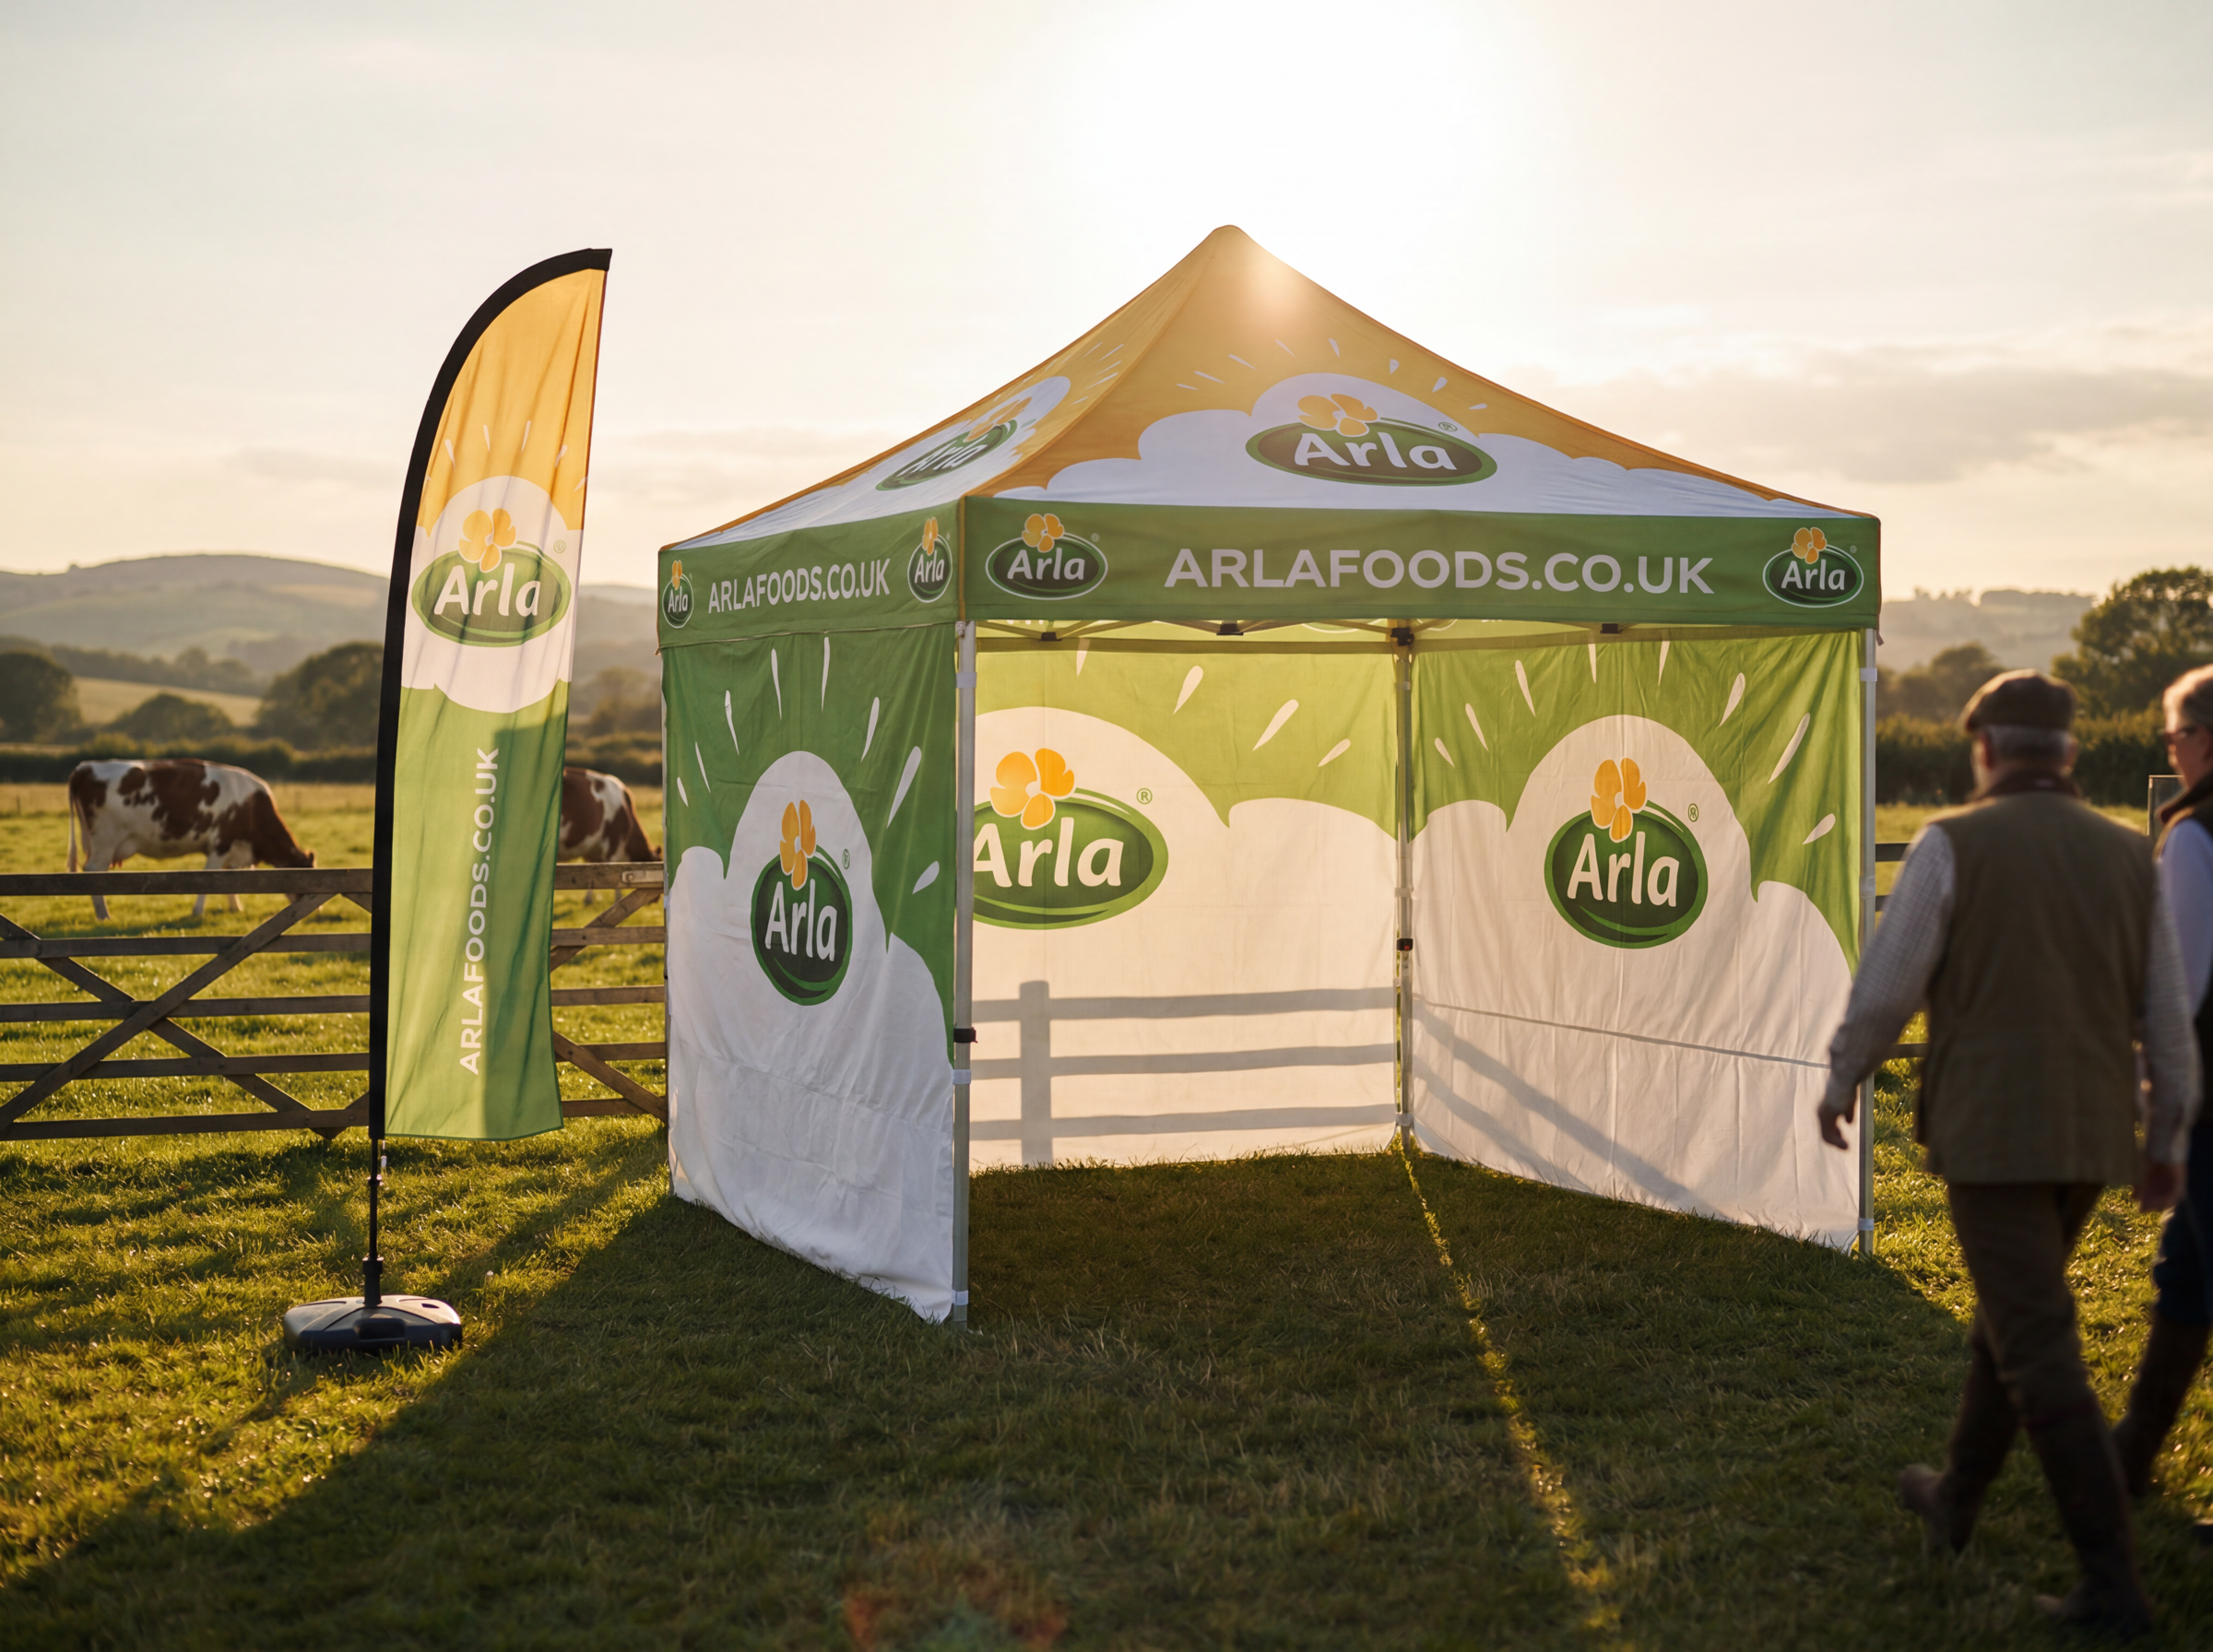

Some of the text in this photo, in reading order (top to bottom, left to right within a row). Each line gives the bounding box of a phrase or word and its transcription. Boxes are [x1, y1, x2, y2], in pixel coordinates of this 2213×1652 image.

[1294, 431, 1458, 470] Arla
[707, 559, 891, 614] ARLAFOODS.CO.UK
[914, 549, 945, 584] Arla
[1007, 548, 1085, 581] Arla
[1164, 549, 1715, 595] ARLAFOODS.CO.UK
[1781, 559, 1847, 591] Arla
[434, 563, 542, 618] Arla
[668, 585, 689, 613] Arla
[973, 817, 1124, 888] Arla
[1567, 831, 1680, 907] Arla
[461, 747, 499, 1076] ARLAFOODS.CO.UK
[764, 879, 838, 962] Arla
